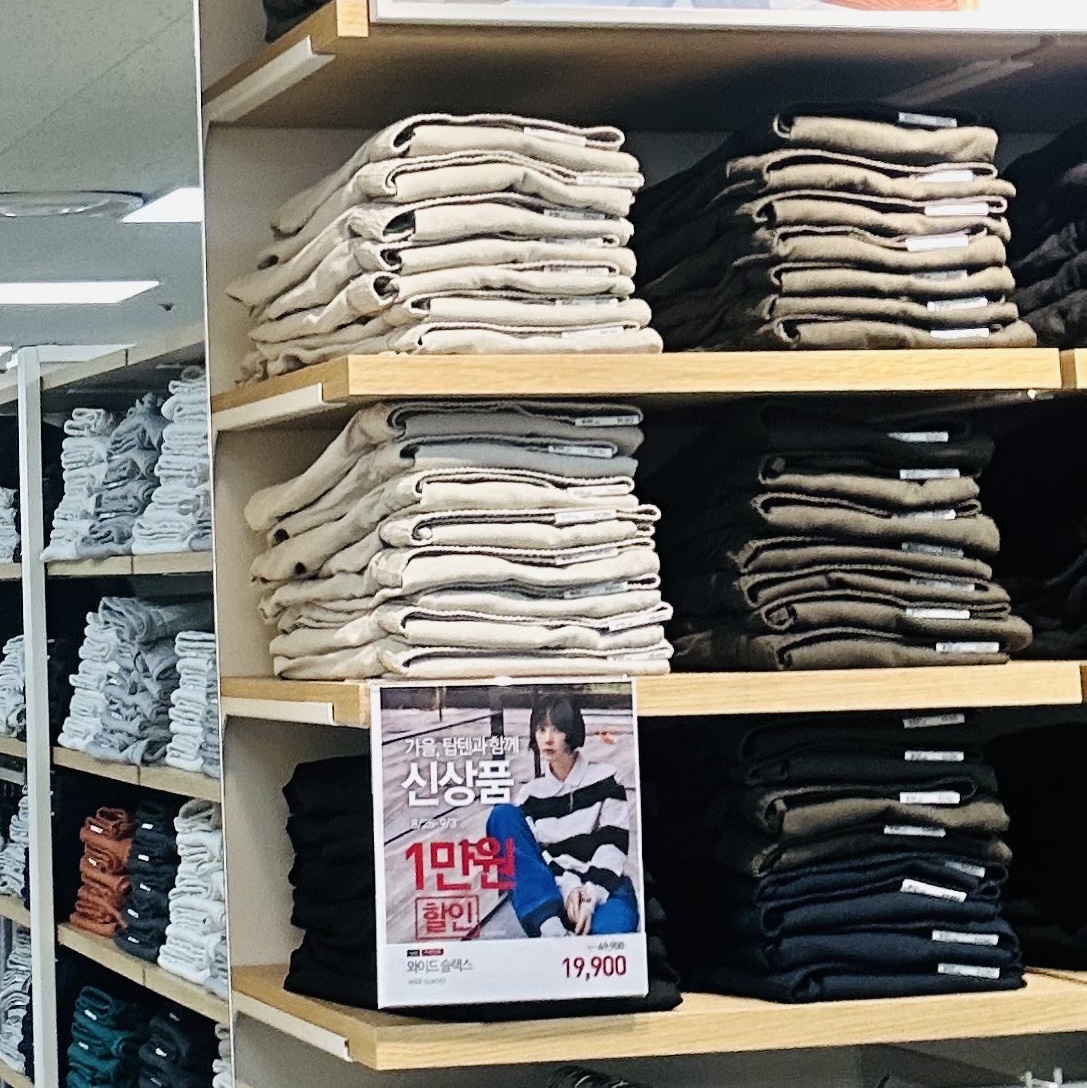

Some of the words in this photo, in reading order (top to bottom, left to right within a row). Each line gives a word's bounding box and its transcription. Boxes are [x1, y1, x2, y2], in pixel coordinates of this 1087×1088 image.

[405, 738, 440, 758] 가을,
[490, 735, 520, 755] 함께
[402, 760, 515, 807] 신상품
[405, 838, 516, 891] 1만원
[422, 902, 474, 934] 할인
[407, 959, 439, 973] 와이드
[562, 955, 627, 981] 19,900
